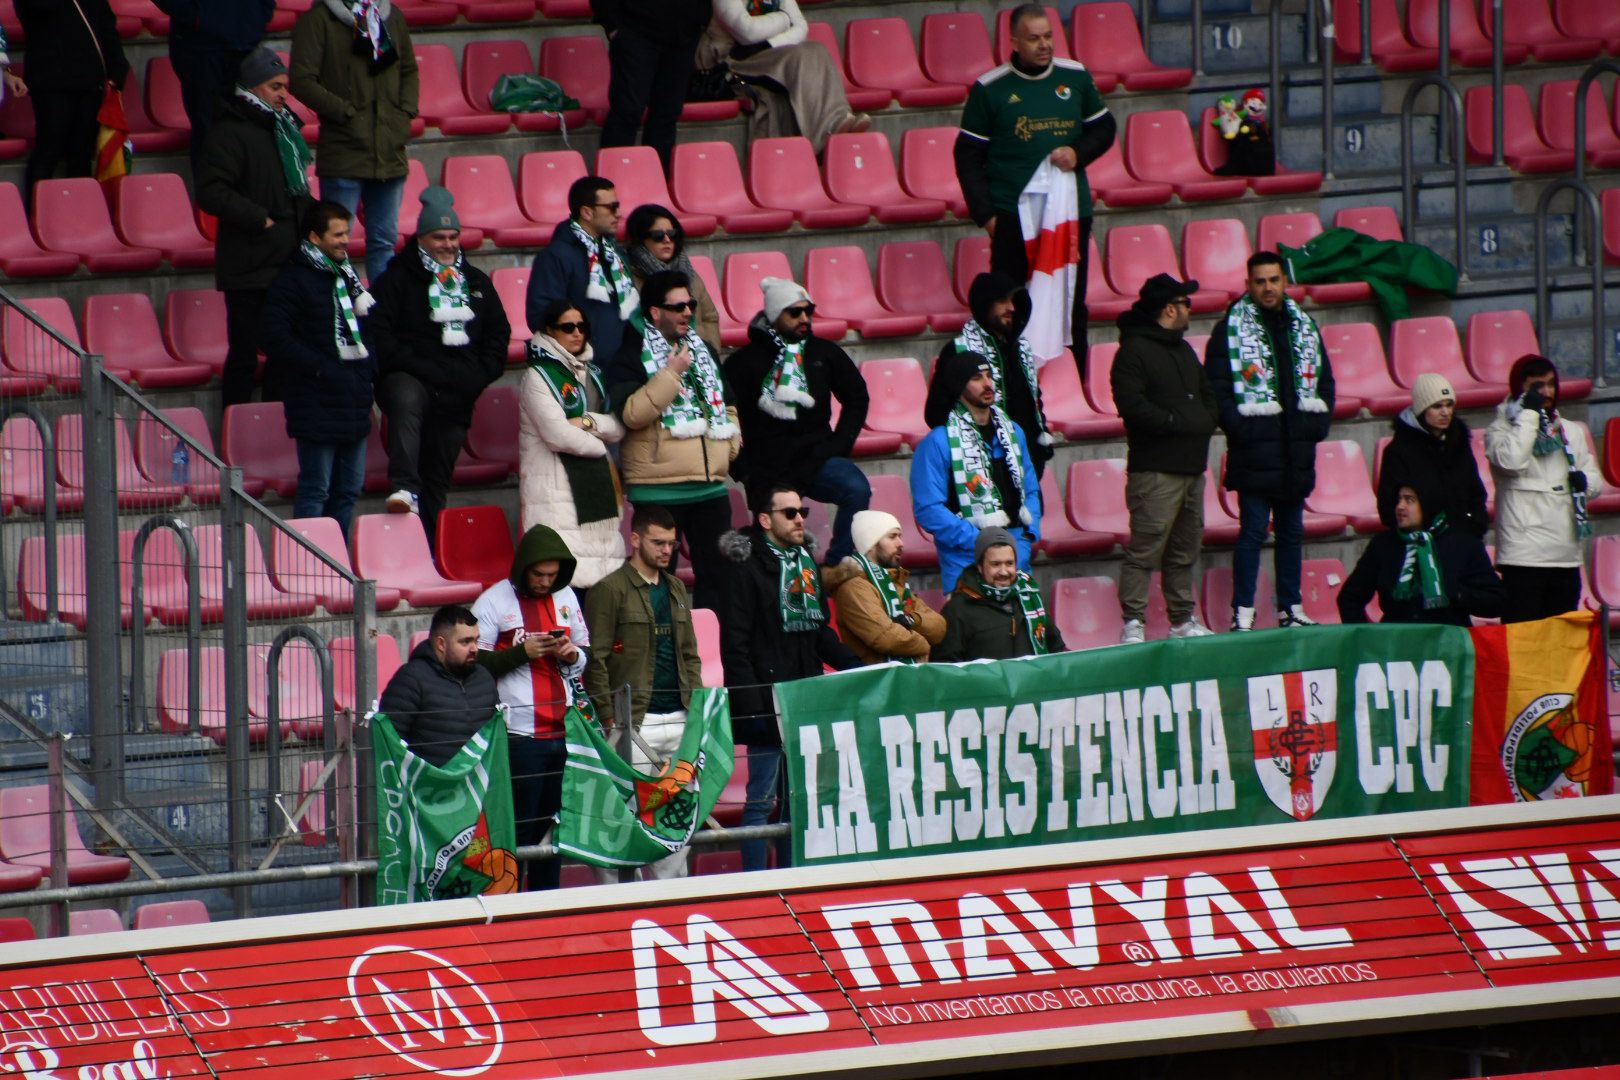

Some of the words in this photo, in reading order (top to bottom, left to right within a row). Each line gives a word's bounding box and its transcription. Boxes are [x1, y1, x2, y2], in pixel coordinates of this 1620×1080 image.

[1212, 26, 1242, 50] 10
[1347, 128, 1362, 153] 9
[1482, 229, 1497, 252] 8
[1266, 688, 1278, 711] L
[1309, 682, 1323, 706] R
[799, 720, 878, 859] LA
[878, 679, 1236, 851] RESISTENCIA
[1355, 660, 1452, 795] CPC
[172, 805, 187, 830] 4
[575, 778, 634, 853] 19
[457, 828, 477, 847] LUB
[426, 845, 457, 893] POLIDEPO
[821, 866, 1354, 992] MAVYAL
[371, 970, 491, 1049] M
[866, 1000, 912, 1026] No
[912, 989, 1062, 1022] inventamos
[1060, 984, 1090, 1008] la
[1209, 970, 1242, 995] la
[1246, 961, 1378, 994] alquilamos
